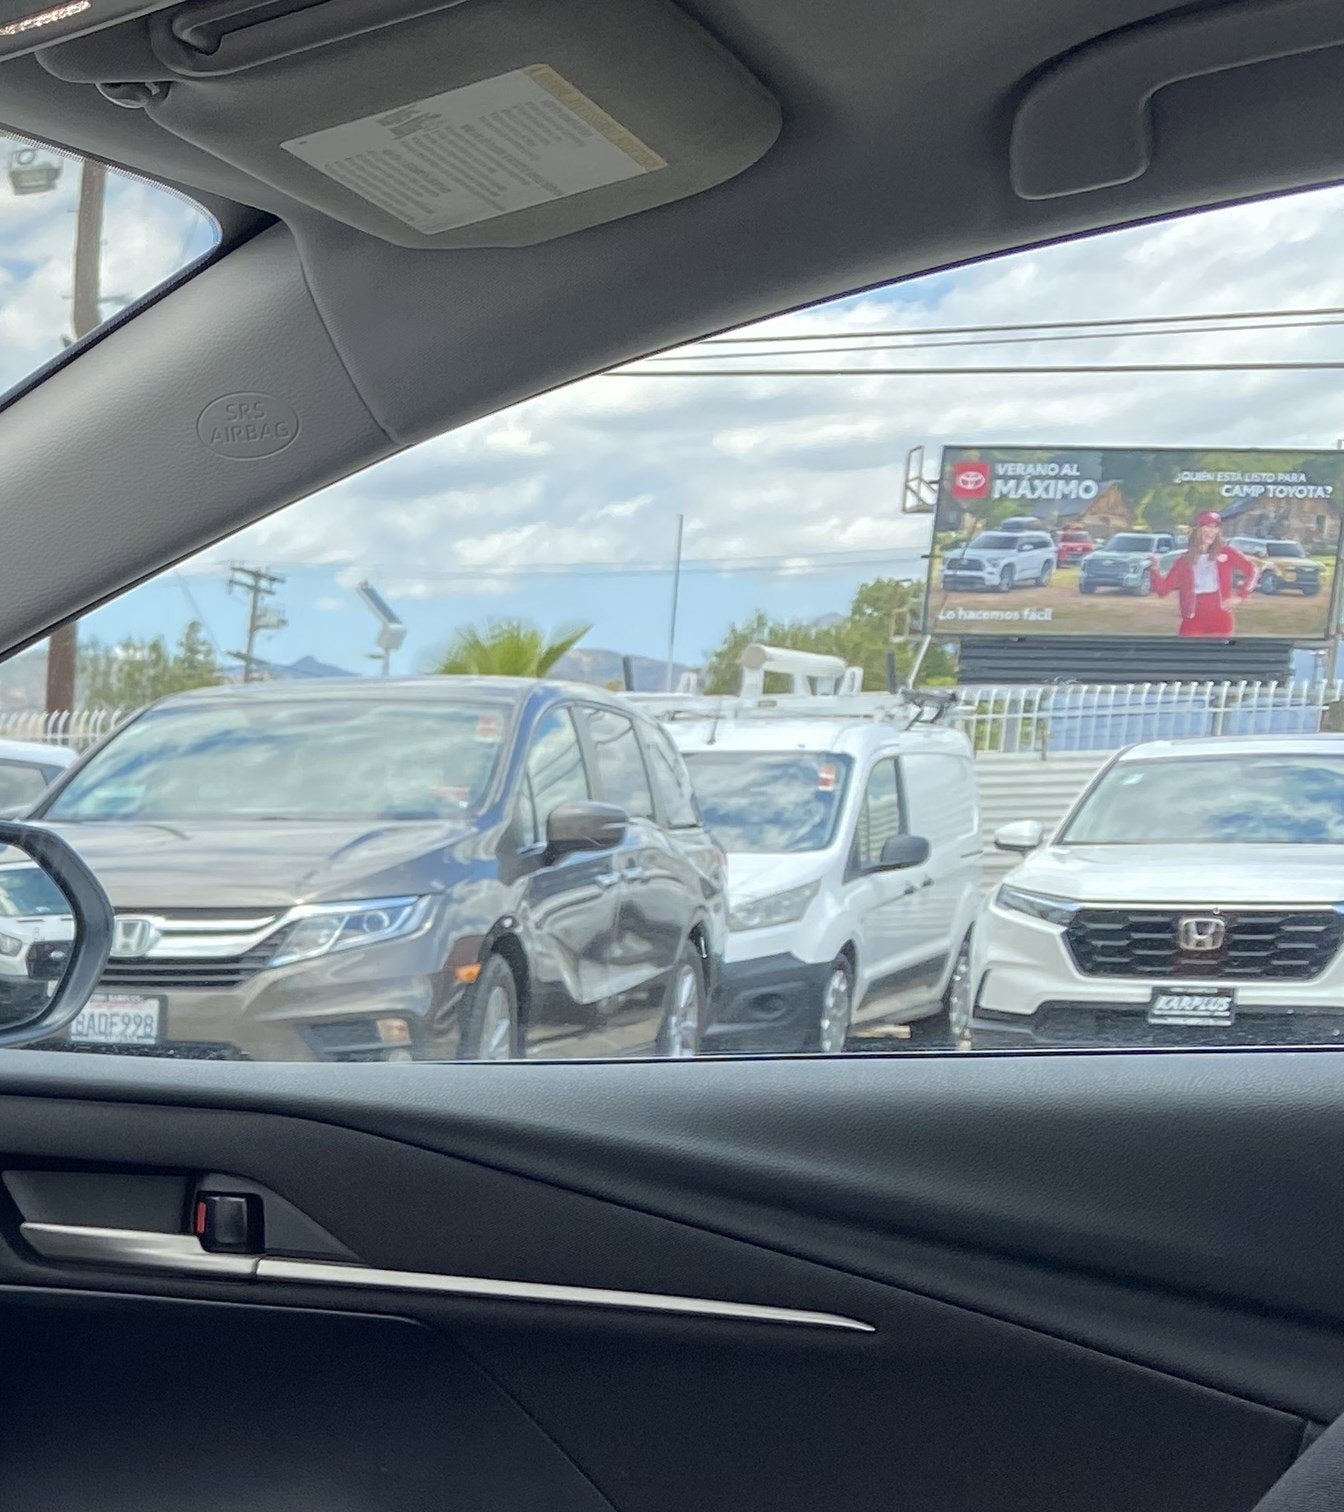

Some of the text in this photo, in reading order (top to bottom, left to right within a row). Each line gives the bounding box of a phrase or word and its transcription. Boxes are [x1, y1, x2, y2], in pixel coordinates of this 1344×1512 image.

[224, 401, 267, 422] SRS
[211, 422, 290, 445] AIRBAG
[997, 462, 1081, 476] VERANO AL
[1245, 472, 1276, 482] LISTO
[1277, 472, 1307, 483] PARA
[993, 474, 1099, 500] MÁXIMO
[1221, 485, 1333, 498] CAMP TOYOTA?
[938, 608, 956, 620] Lo
[958, 607, 1021, 620] hacemos
